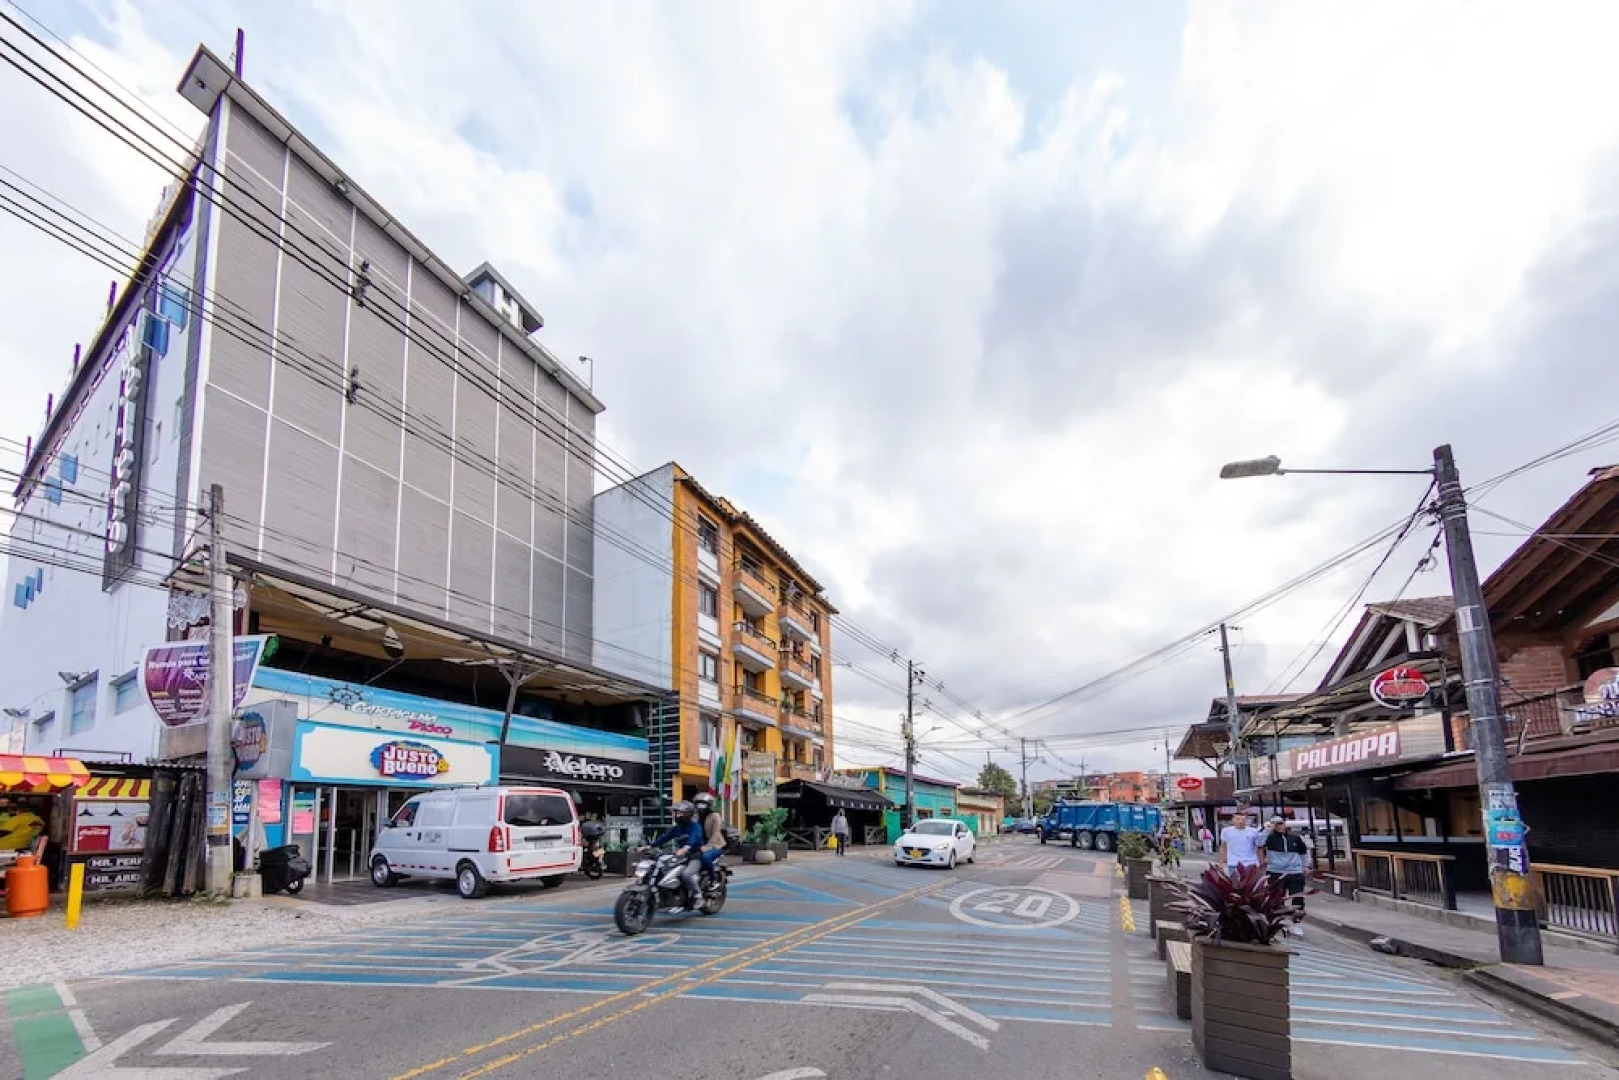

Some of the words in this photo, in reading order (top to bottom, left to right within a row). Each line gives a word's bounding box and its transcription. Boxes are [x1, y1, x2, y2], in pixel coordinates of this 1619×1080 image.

[382, 745, 438, 764] JUSTO
[547, 750, 624, 778] Velero
[1296, 731, 1398, 771] PALUAPA
[972, 891, 1053, 918] 20
